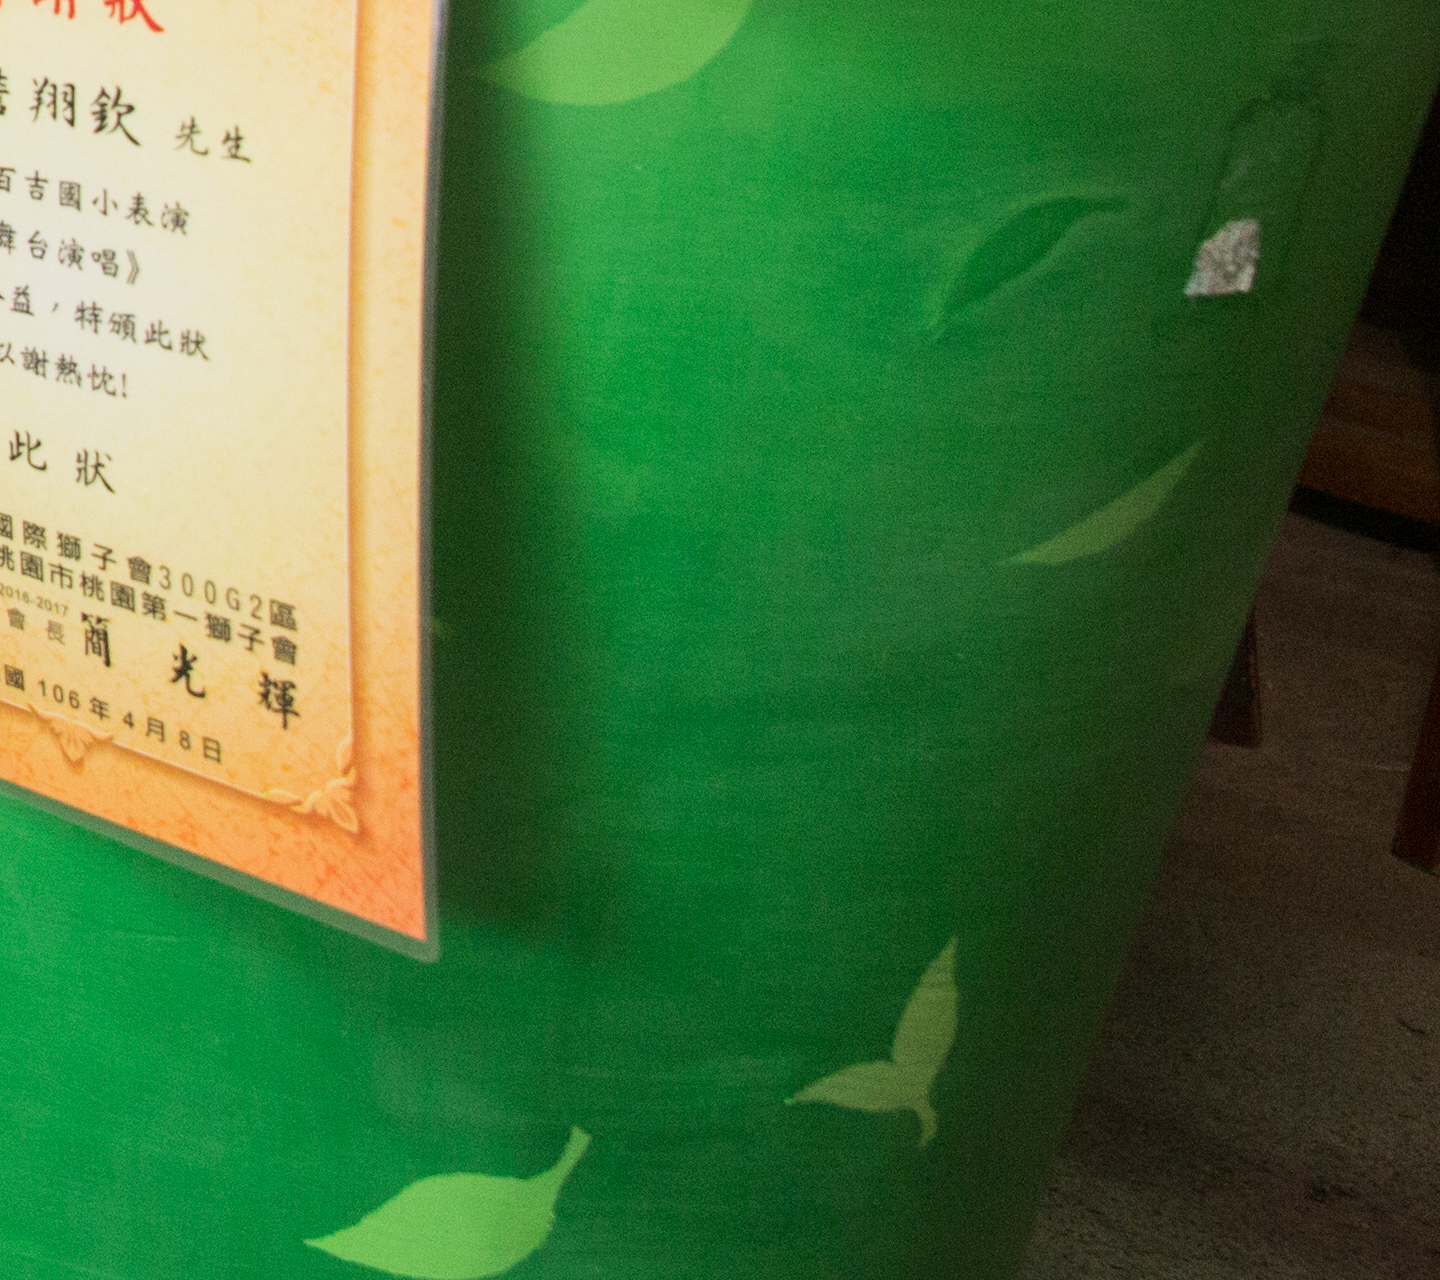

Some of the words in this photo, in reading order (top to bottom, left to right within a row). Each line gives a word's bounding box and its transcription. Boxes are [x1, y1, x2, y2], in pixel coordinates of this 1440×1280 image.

[174, 117, 253, 165] 先生
[7, 430, 117, 495] 此狀
[6, 606, 66, 648] 會長
[81, 613, 302, 731] 簡光輝
